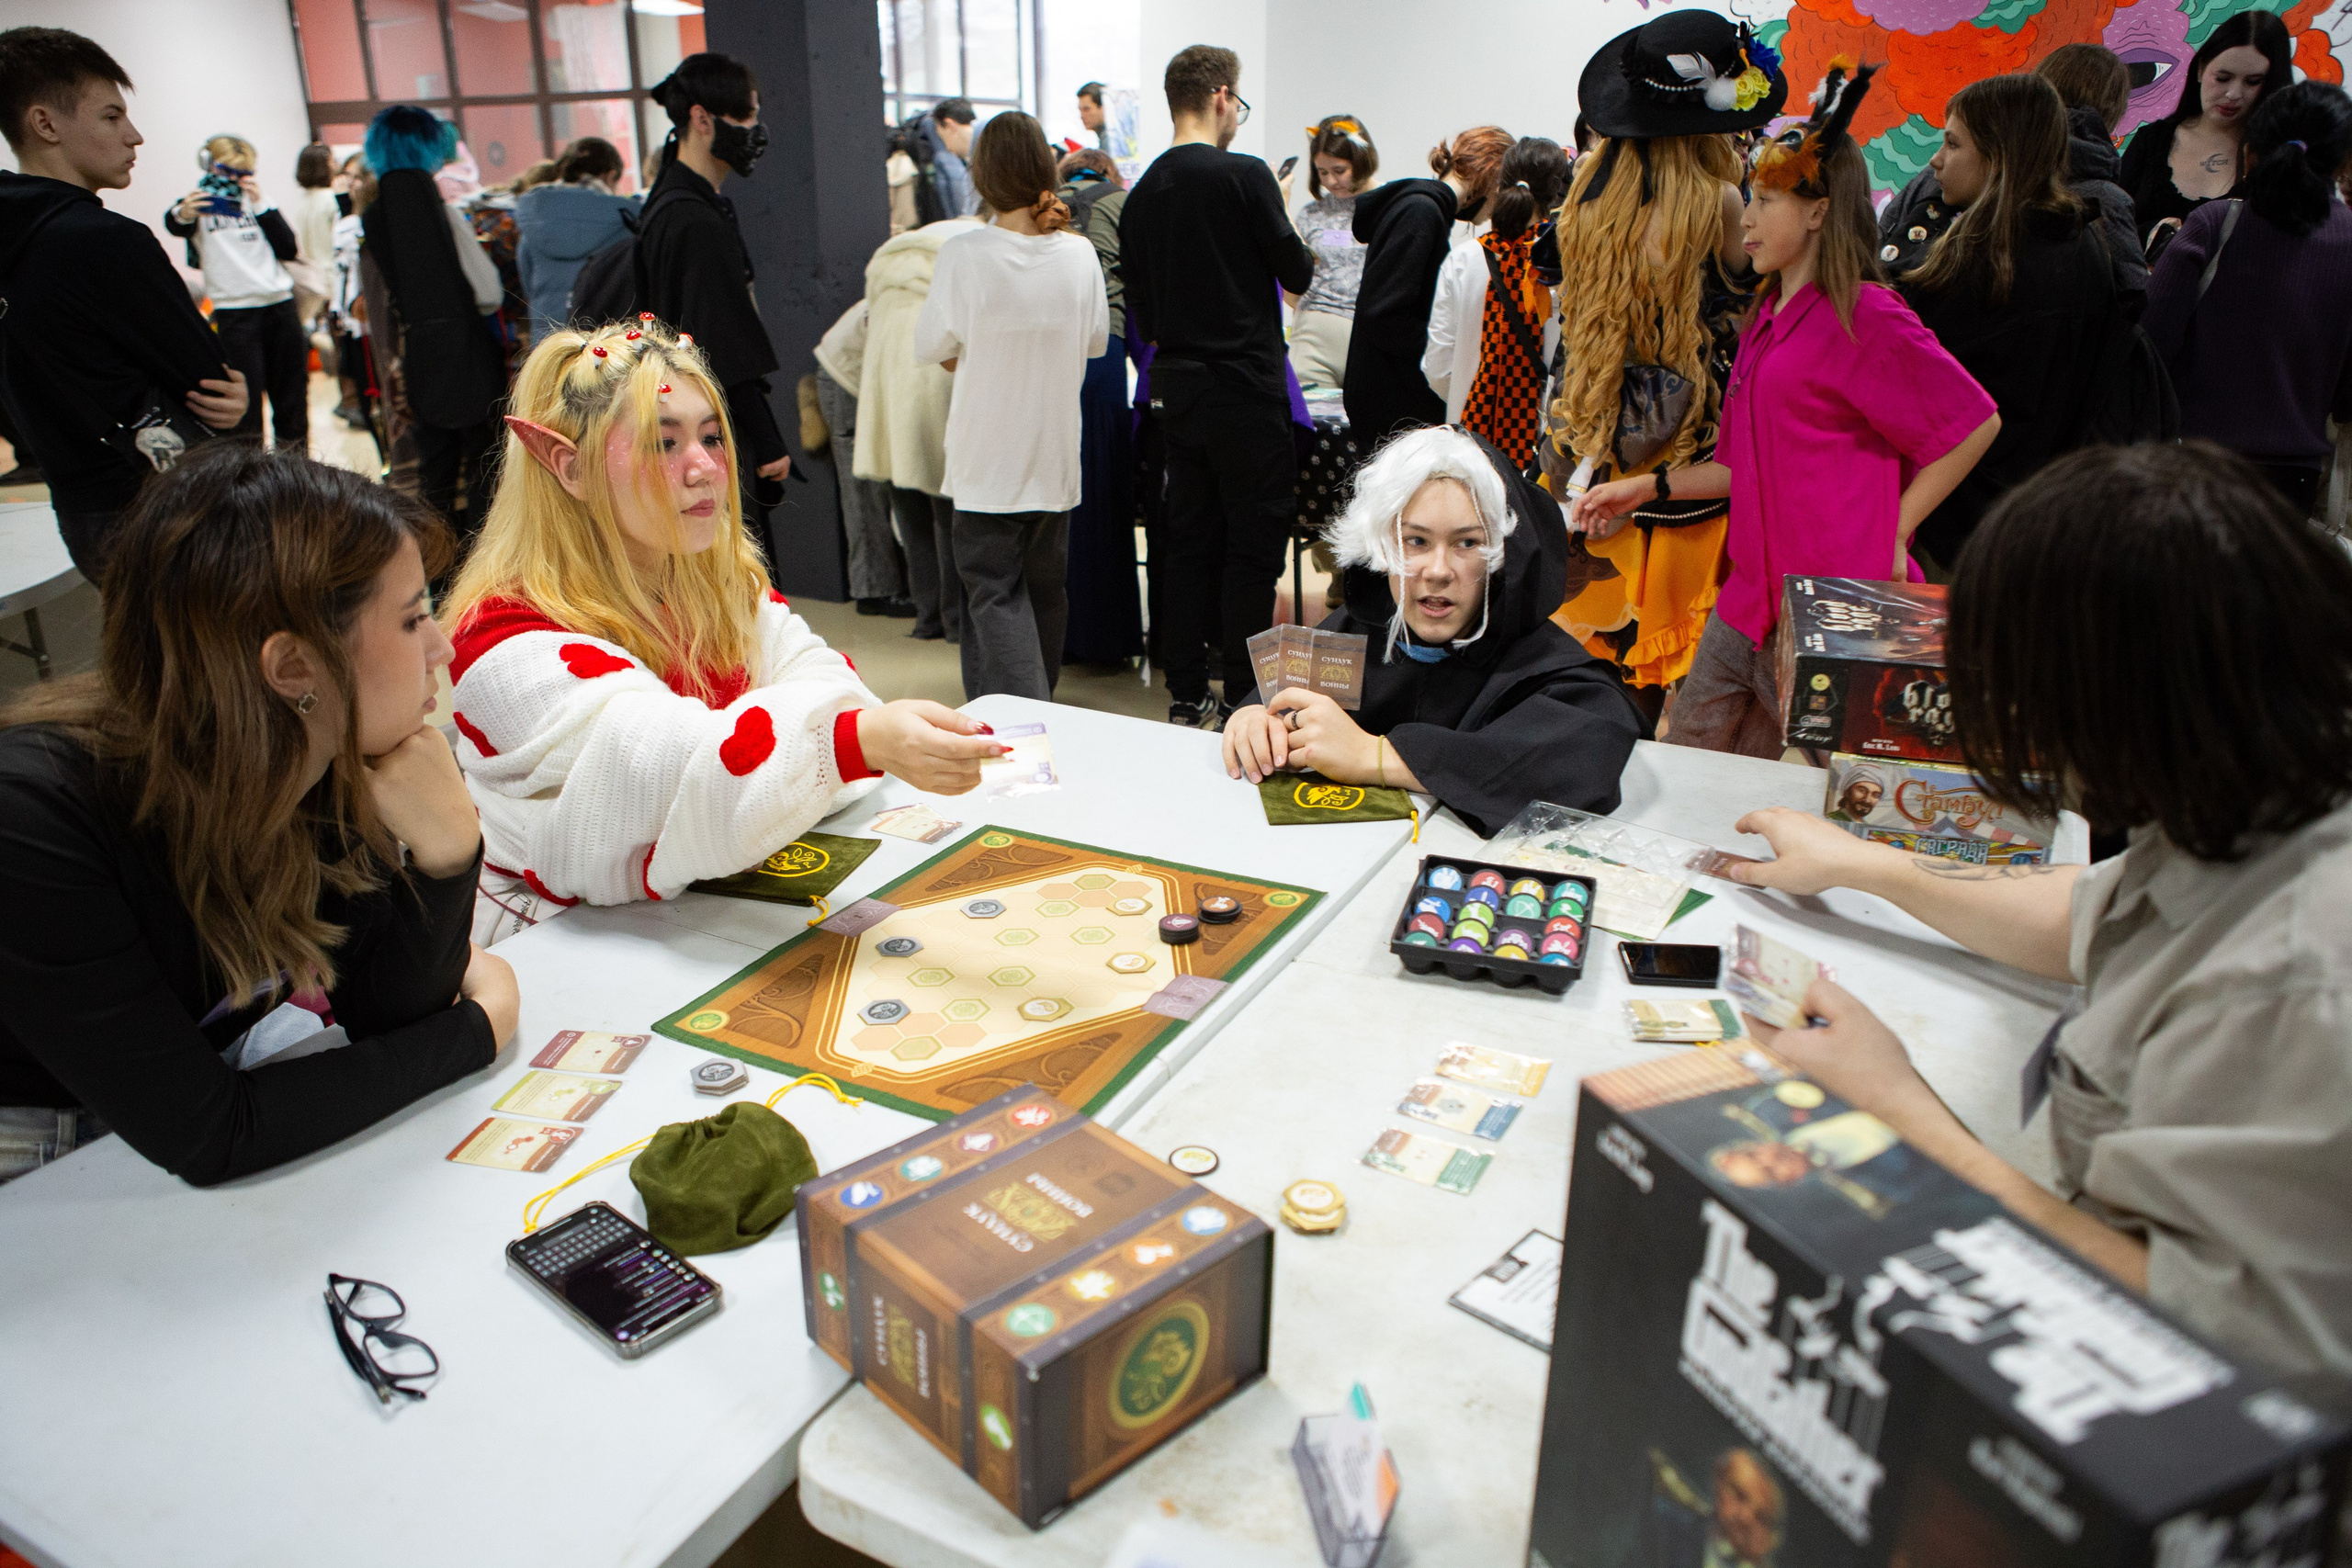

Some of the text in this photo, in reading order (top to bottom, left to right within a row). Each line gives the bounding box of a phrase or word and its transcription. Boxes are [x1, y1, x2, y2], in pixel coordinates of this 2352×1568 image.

[1321, 656, 1352, 666] СУНДУК
[1903, 680, 1952, 710] blo
[1908, 706, 1956, 735] rag
[1894, 779, 2004, 829] Стамбул
[962, 1201, 1034, 1253] СУНДУК
